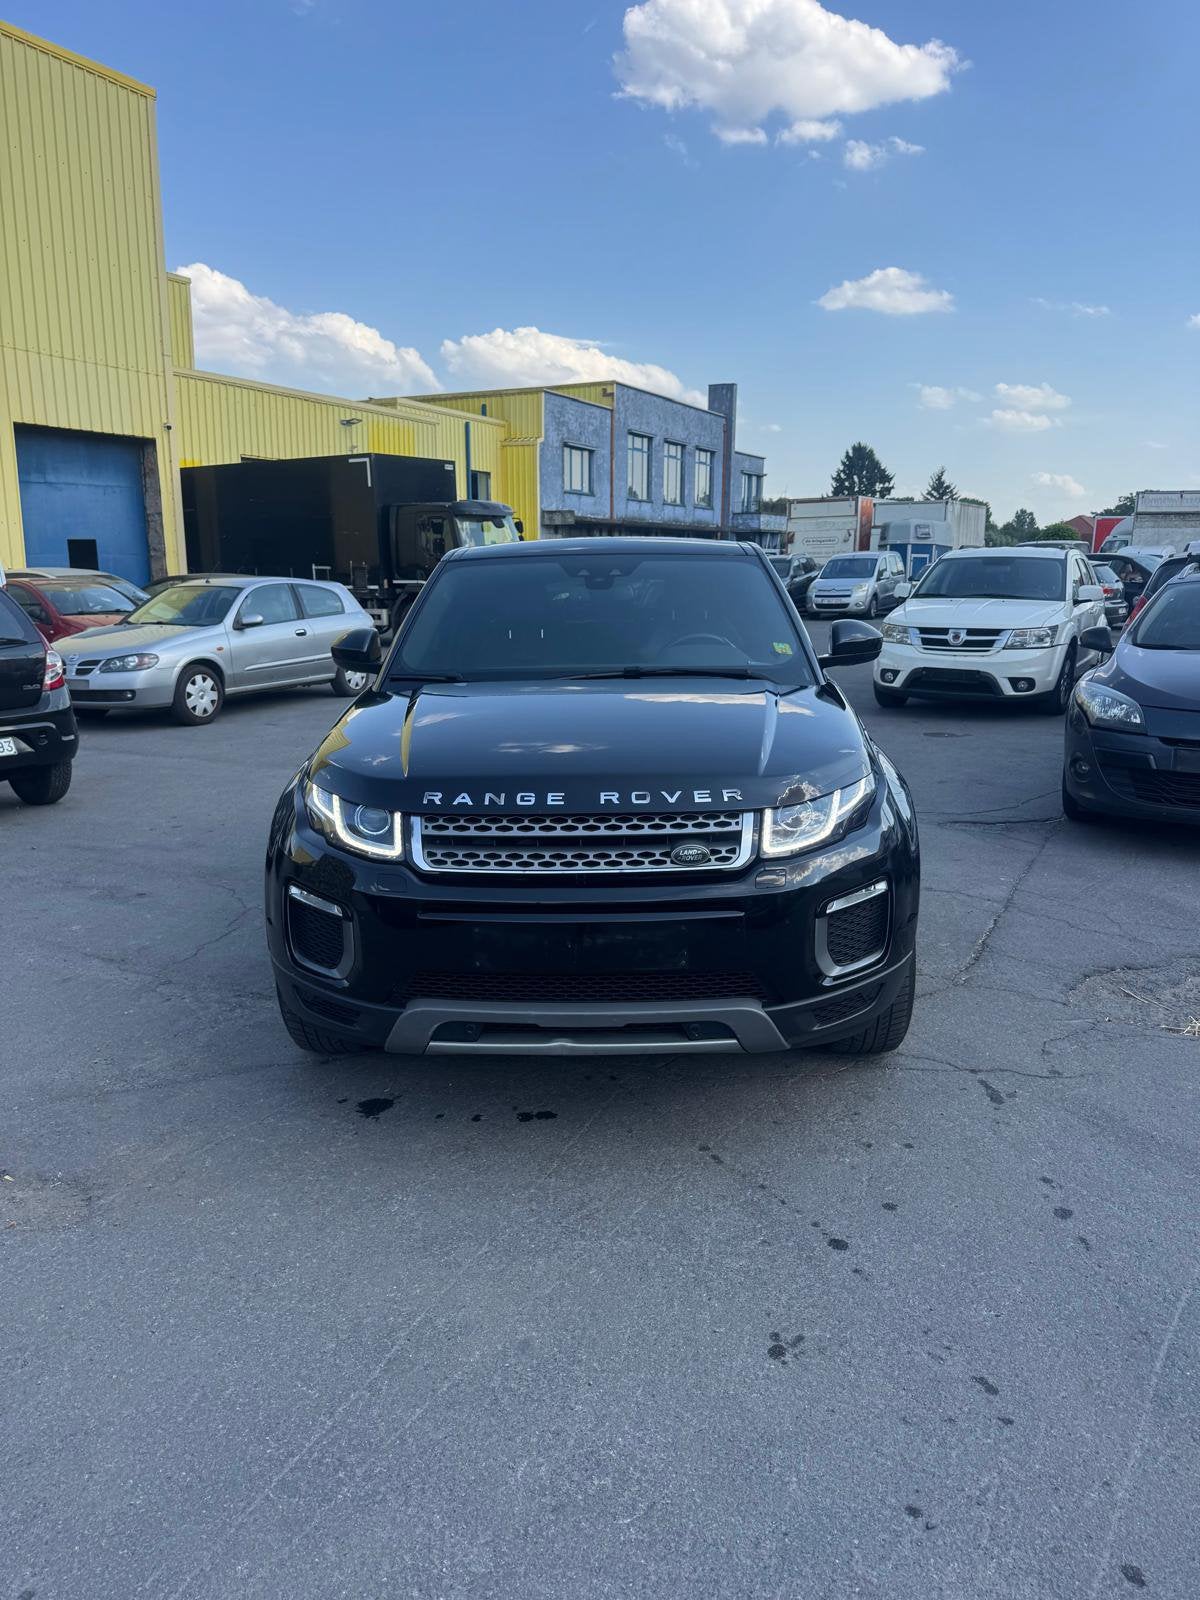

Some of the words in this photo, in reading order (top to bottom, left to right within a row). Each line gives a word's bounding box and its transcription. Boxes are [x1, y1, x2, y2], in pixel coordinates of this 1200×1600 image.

[422, 791, 565, 805] RANGE
[600, 788, 743, 804] ROVER
[681, 854, 703, 862] ROVER
